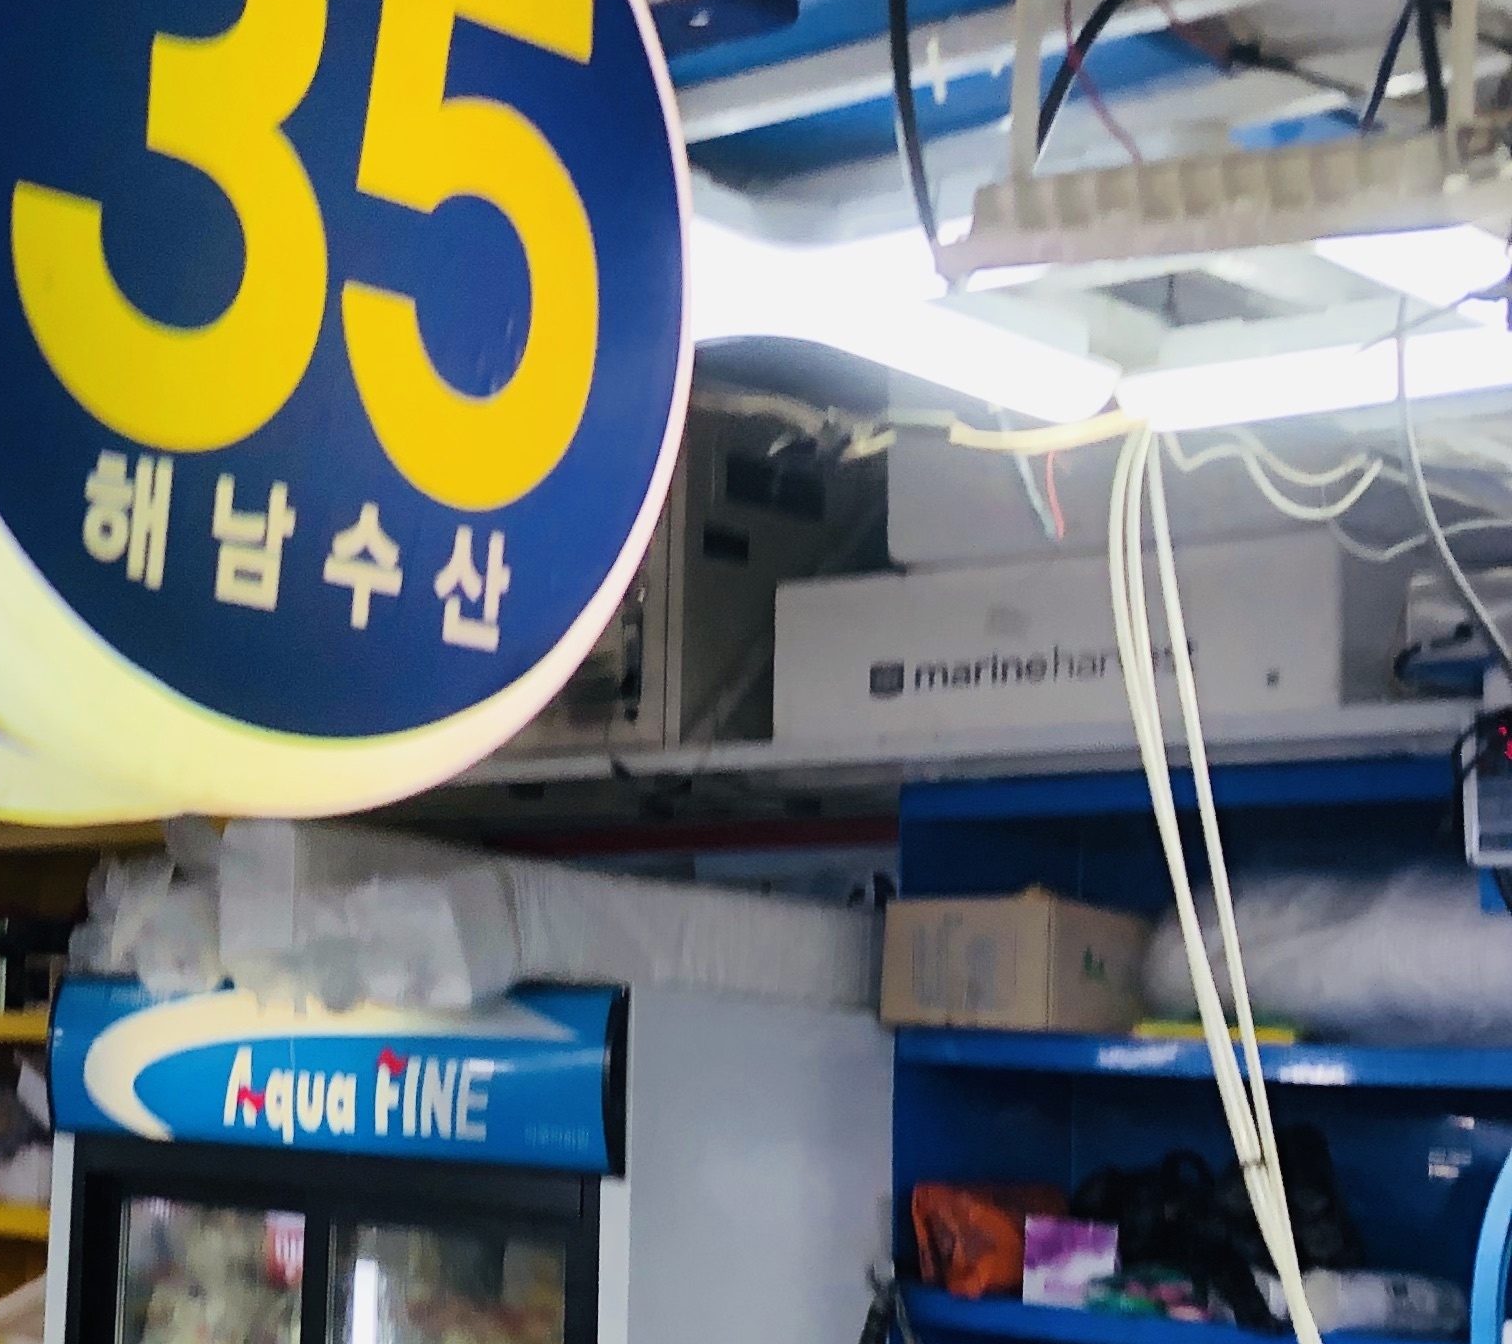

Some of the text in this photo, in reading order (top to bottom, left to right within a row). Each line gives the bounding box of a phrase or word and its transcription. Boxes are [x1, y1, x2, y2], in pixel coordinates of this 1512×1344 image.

[83, 450, 509, 652] 해남수산
[223, 1045, 492, 1145] Aqua FINE
